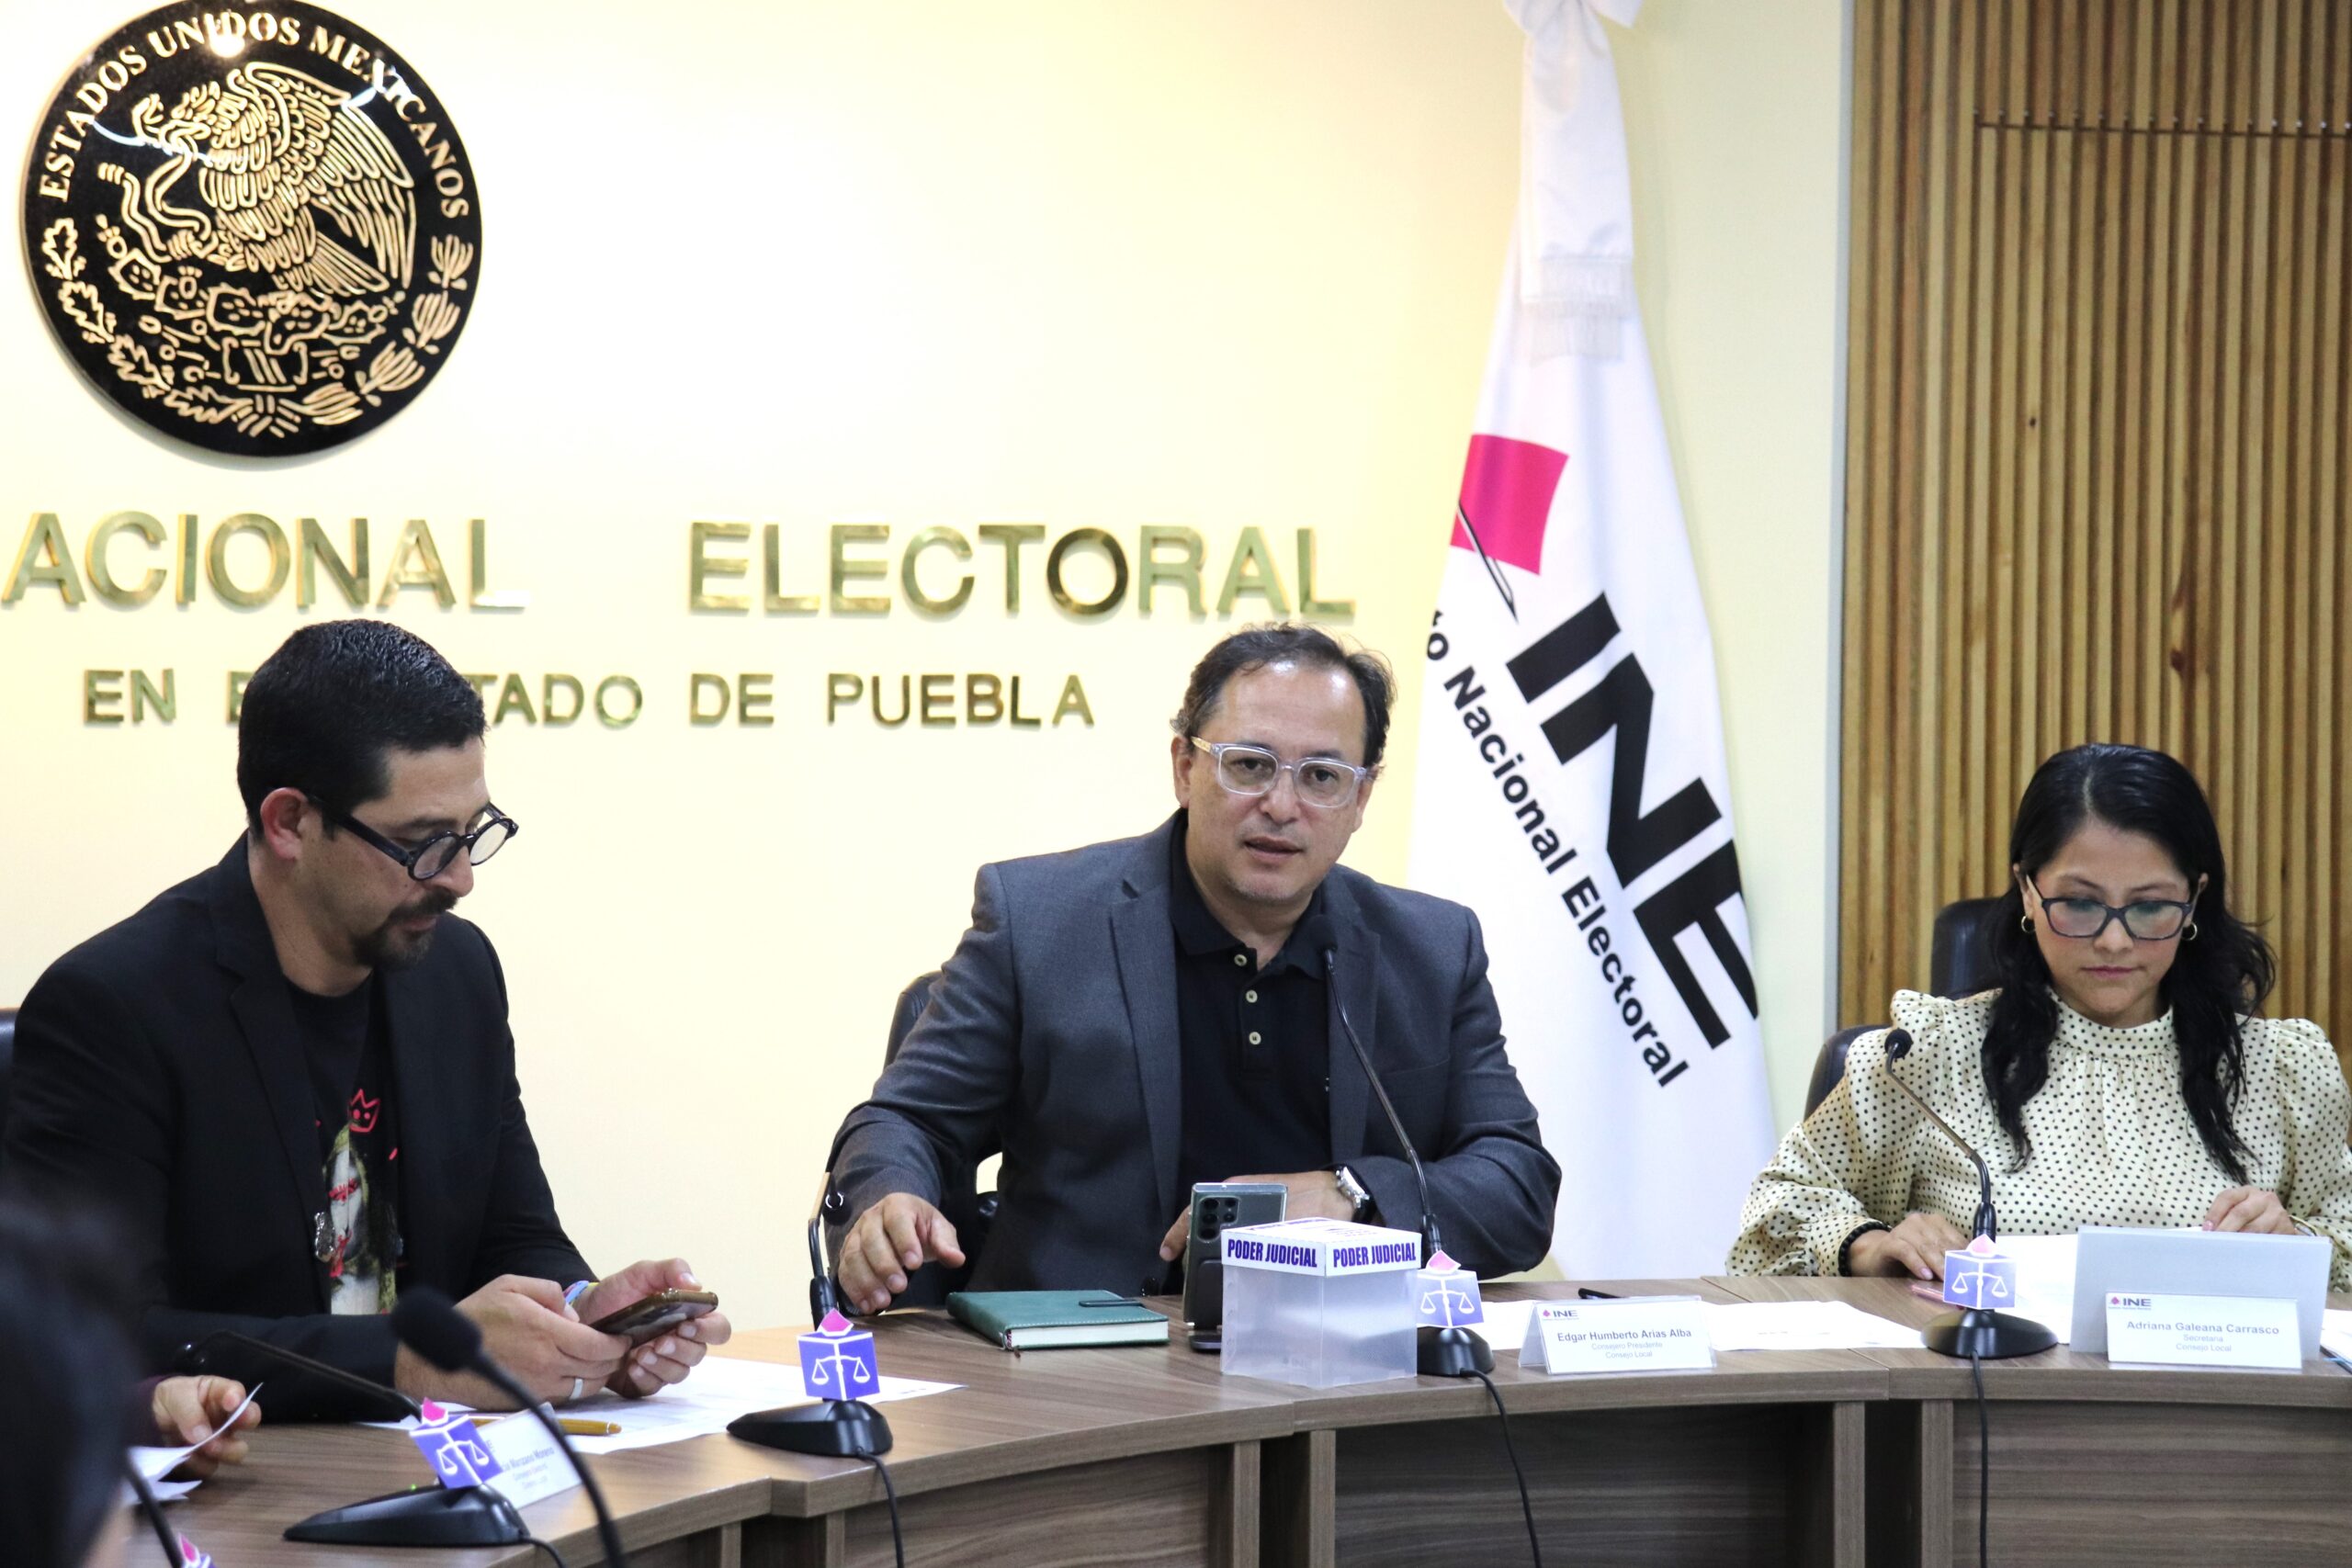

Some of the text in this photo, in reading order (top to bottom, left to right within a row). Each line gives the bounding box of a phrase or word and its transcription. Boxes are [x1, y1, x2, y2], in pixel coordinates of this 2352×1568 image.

[40, 11, 469, 220] ESTADOS UNIDOS MEXICANOS
[689, 522, 1356, 615] ELECTORAL
[85, 669, 176, 724] EN
[460, 672, 644, 729] TADO
[689, 672, 775, 725] DE
[827, 672, 1095, 727] PUEBLA
[1505, 591, 1759, 1050] INE
[1443, 664, 1577, 874] Nacional
[1561, 875, 1689, 1088] Electoral
[1227, 1238, 1317, 1268] PODER JUDICIAL
[1333, 1242, 1417, 1268] PODER JUDICIAL
[1553, 1310, 1578, 1318] INE
[2123, 1298, 2152, 1307] INE
[1557, 1327, 1692, 1343] Edgar Humberto Arias Alba
[2127, 1321, 2279, 1335] Adriana Galeana Carrasco
